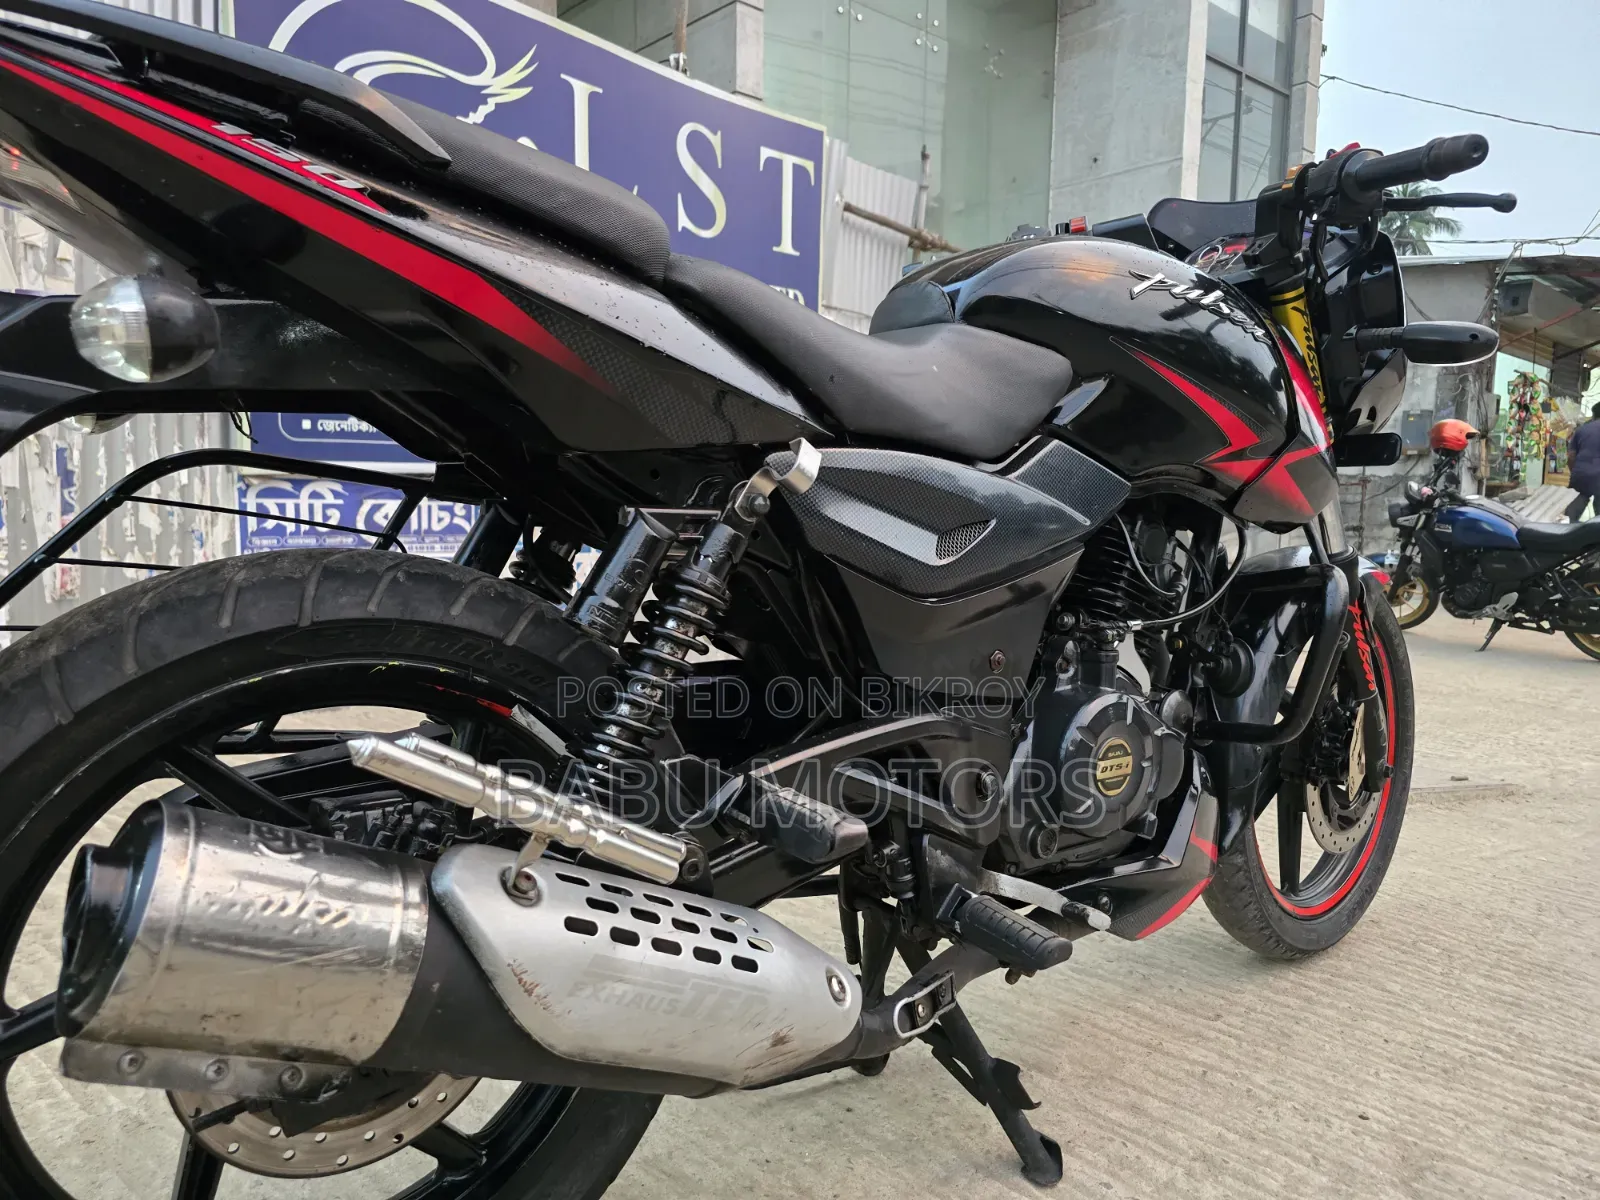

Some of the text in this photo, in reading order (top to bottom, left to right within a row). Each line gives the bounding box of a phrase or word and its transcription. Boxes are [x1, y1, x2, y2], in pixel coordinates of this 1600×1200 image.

[212, 121, 365, 189] 150
[1128, 269, 1273, 345] Pulsar
[242, 480, 349, 537] সিটি
